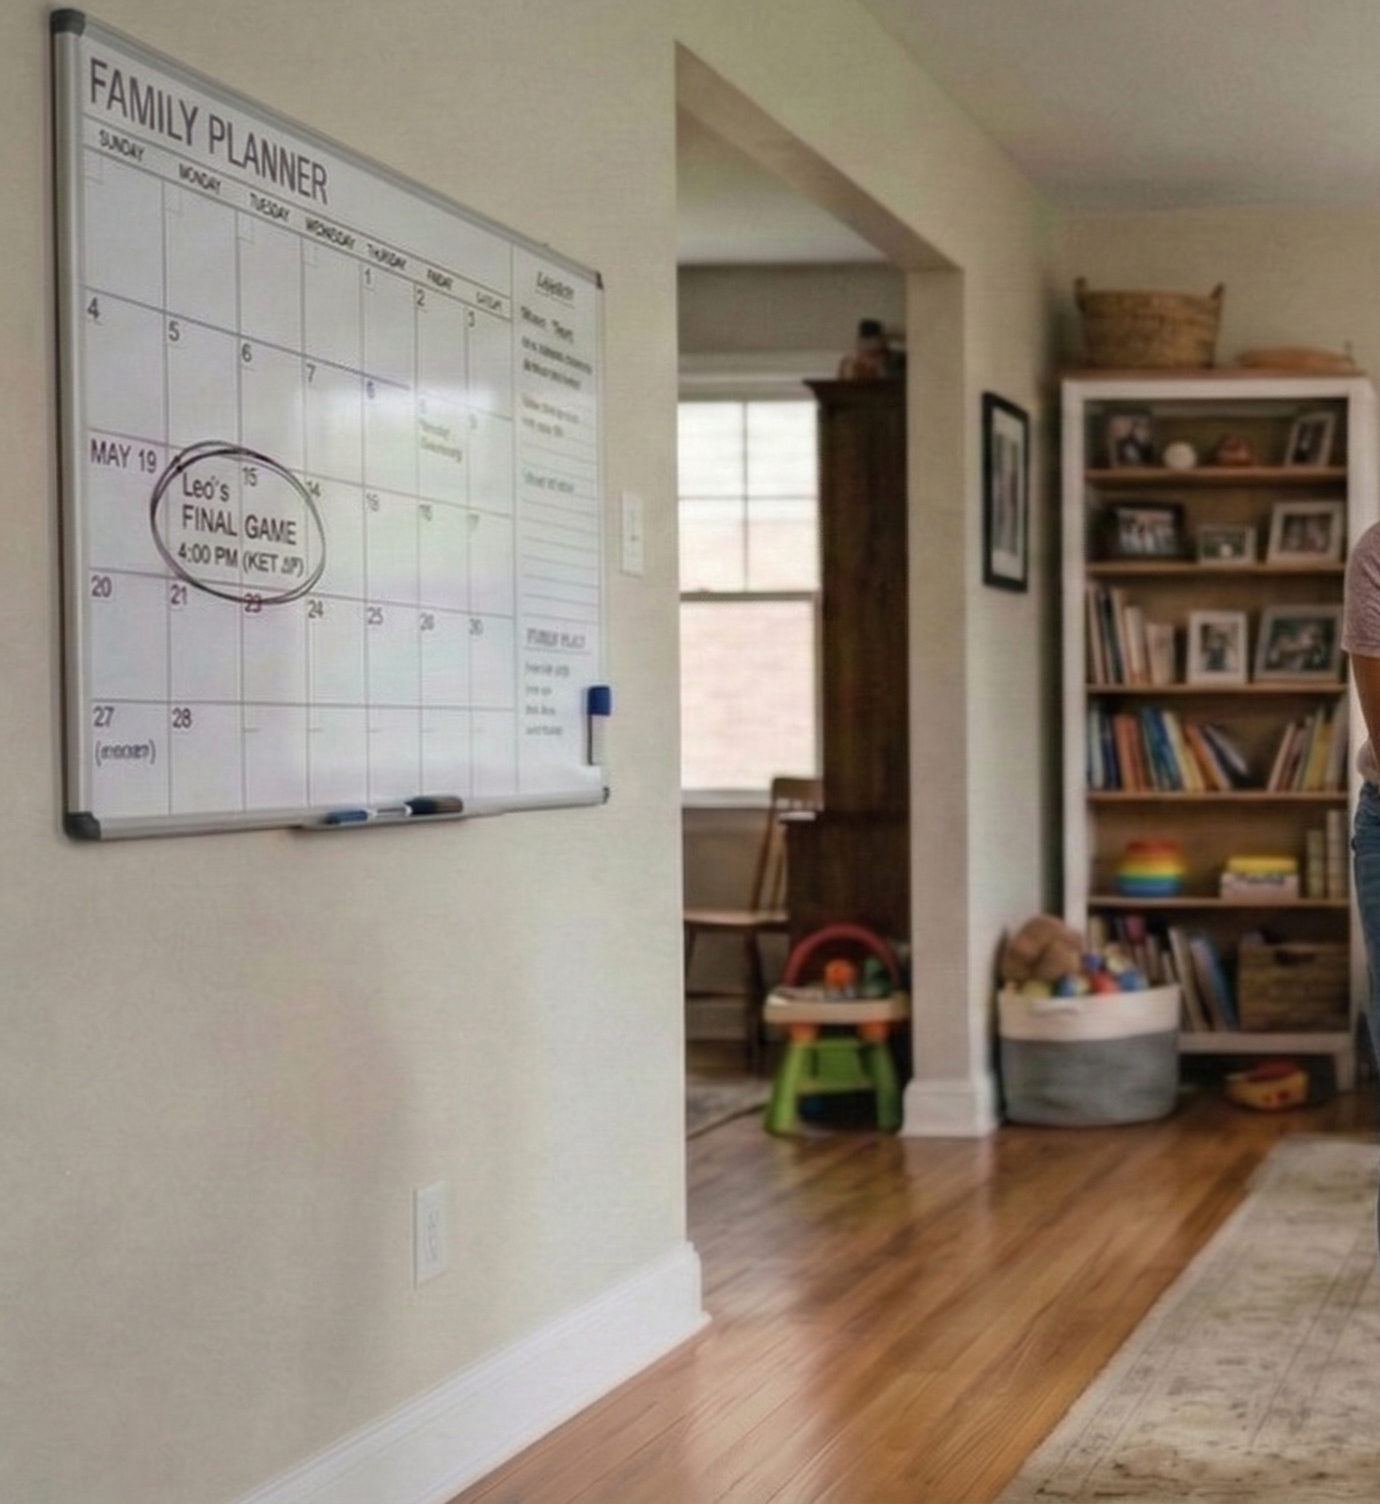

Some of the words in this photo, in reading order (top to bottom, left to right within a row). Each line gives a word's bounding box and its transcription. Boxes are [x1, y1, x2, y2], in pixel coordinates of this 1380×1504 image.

[90, 57, 198, 146] FAMILY
[209, 113, 328, 205] PLANNER
[99, 129, 144, 161] SUNDAY
[179, 163, 220, 195] MONDAY
[87, 298, 101, 319] 4
[417, 288, 425, 307] 2
[168, 320, 180, 342] 5
[241, 343, 253, 363] 6
[306, 363, 317, 385] 7
[91, 439, 131, 468] MAY
[138, 450, 157, 474] 19
[182, 503, 238, 537] FINAL
[244, 514, 297, 546] GAME
[177, 542, 211, 565] 4:00
[215, 546, 238, 568] PM
[91, 575, 112, 599] 20
[171, 584, 188, 606] 21
[308, 600, 324, 620] 24
[93, 705, 115, 728] 27
[172, 707, 193, 729] 28
